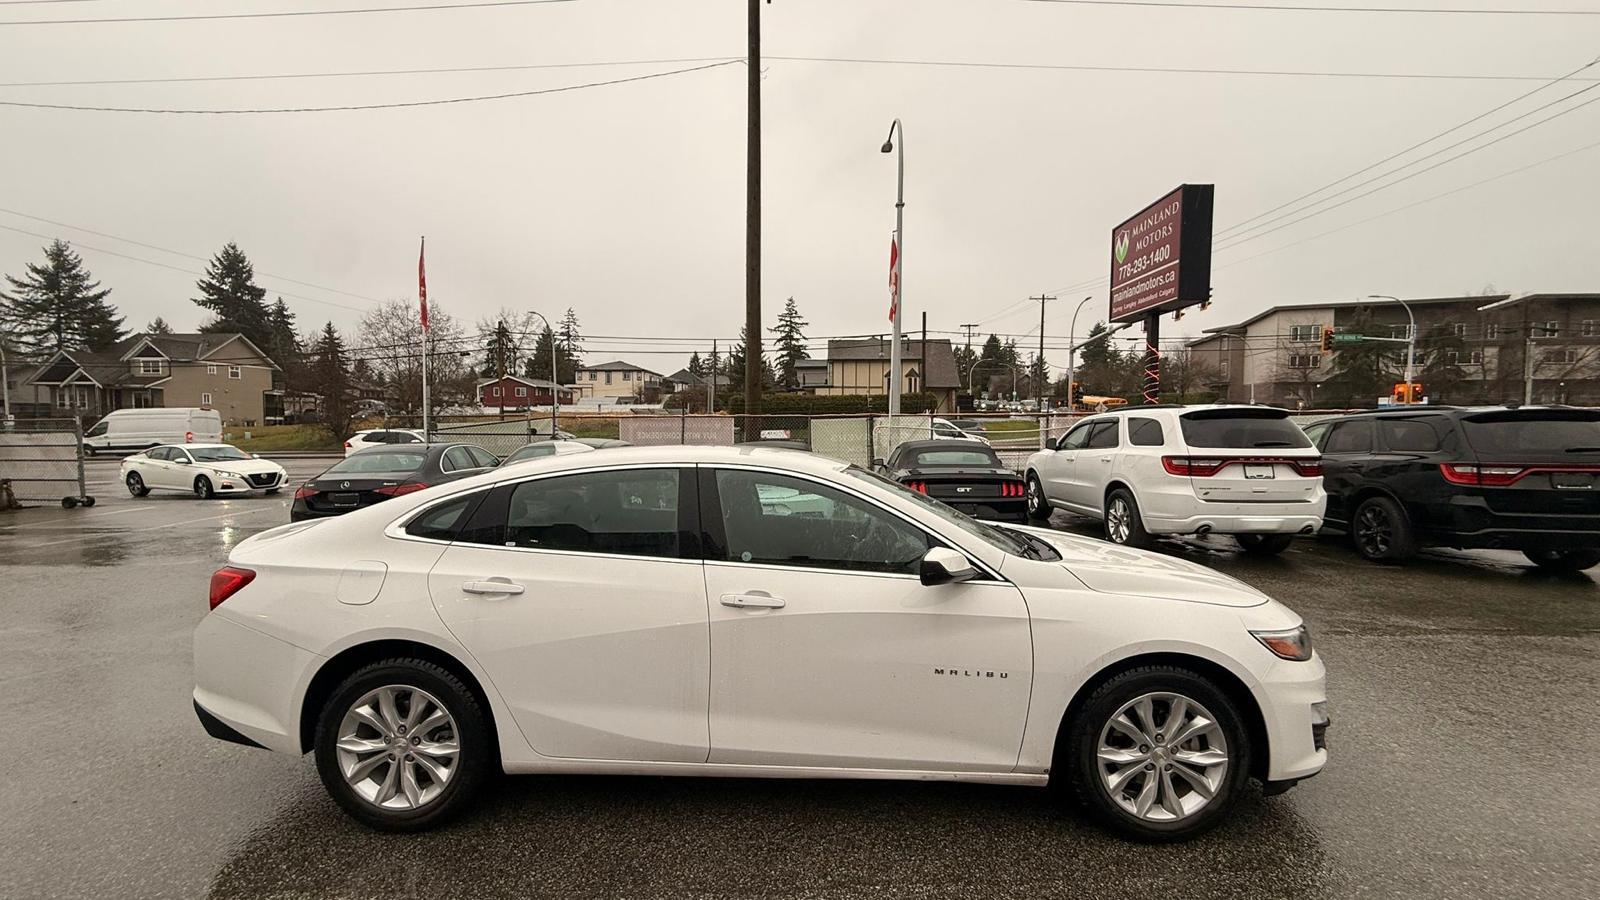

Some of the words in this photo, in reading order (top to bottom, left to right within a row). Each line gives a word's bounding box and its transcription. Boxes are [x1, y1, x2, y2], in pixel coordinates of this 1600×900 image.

[1131, 201, 1180, 238] MAINLAND
[1135, 222, 1173, 252] MOTORS
[1118, 243, 1171, 280] 778-293-1400
[1113, 270, 1175, 303] mainlandmotors.ca
[934, 668, 1008, 679] MALIBU
